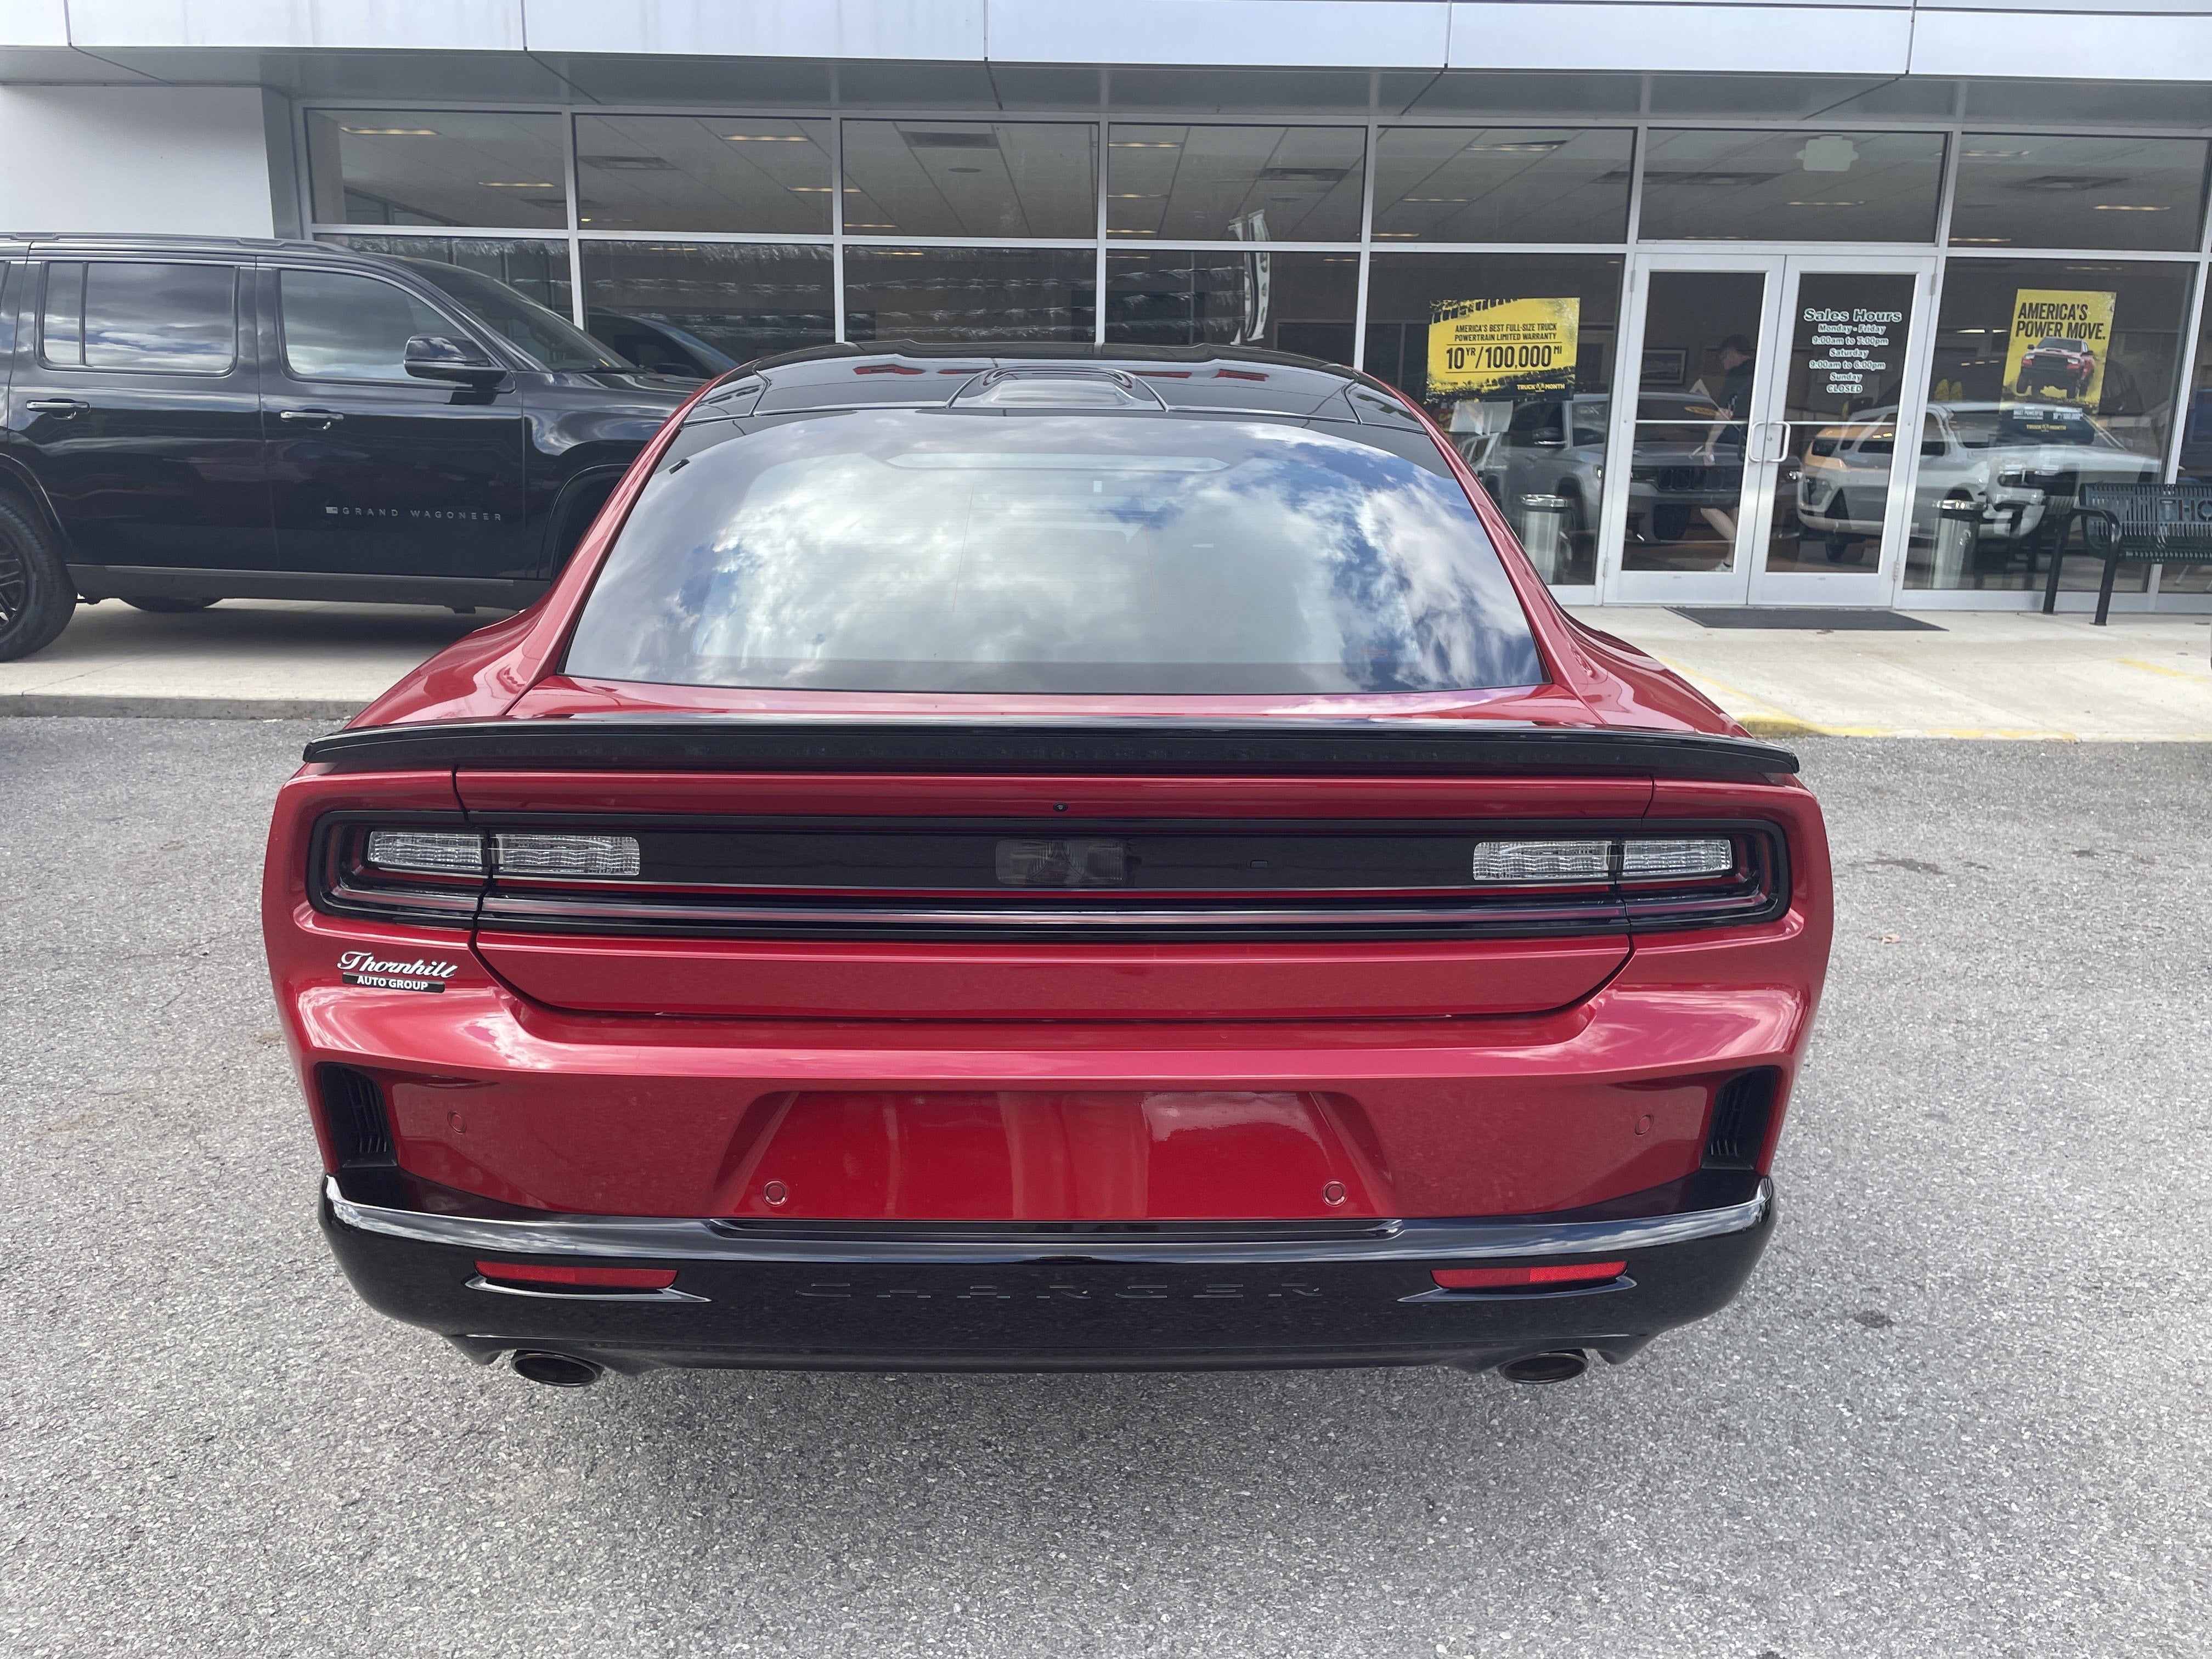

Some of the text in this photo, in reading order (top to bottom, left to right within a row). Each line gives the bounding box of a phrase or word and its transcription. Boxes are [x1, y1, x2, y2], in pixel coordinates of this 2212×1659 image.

[1803, 308, 1902, 323] Sales Hours
[2018, 302, 2089, 321] AMERICA'S
[1455, 323, 1557, 332] AMERICA'S BEST FULL-SIZE TRUCK
[1818, 323, 1853, 335] Monday
[1858, 324, 1887, 335] Friday
[2015, 320, 2106, 340] POWER MOVE.
[1454, 333, 1495, 342] POWERTRAIN
[1845, 336, 1856, 345] to
[1829, 348, 1869, 359] Saturday
[1842, 360, 1853, 369] to
[1830, 372, 1863, 383] Sunday
[1826, 383, 1863, 393] CLOSED
[342, 507, 501, 521] GRAND WAGONEER
[337, 951, 458, 978] Thornhill
[357, 975, 429, 991] AUTO GROUP
[795, 1282, 1322, 1299] CHARGER
